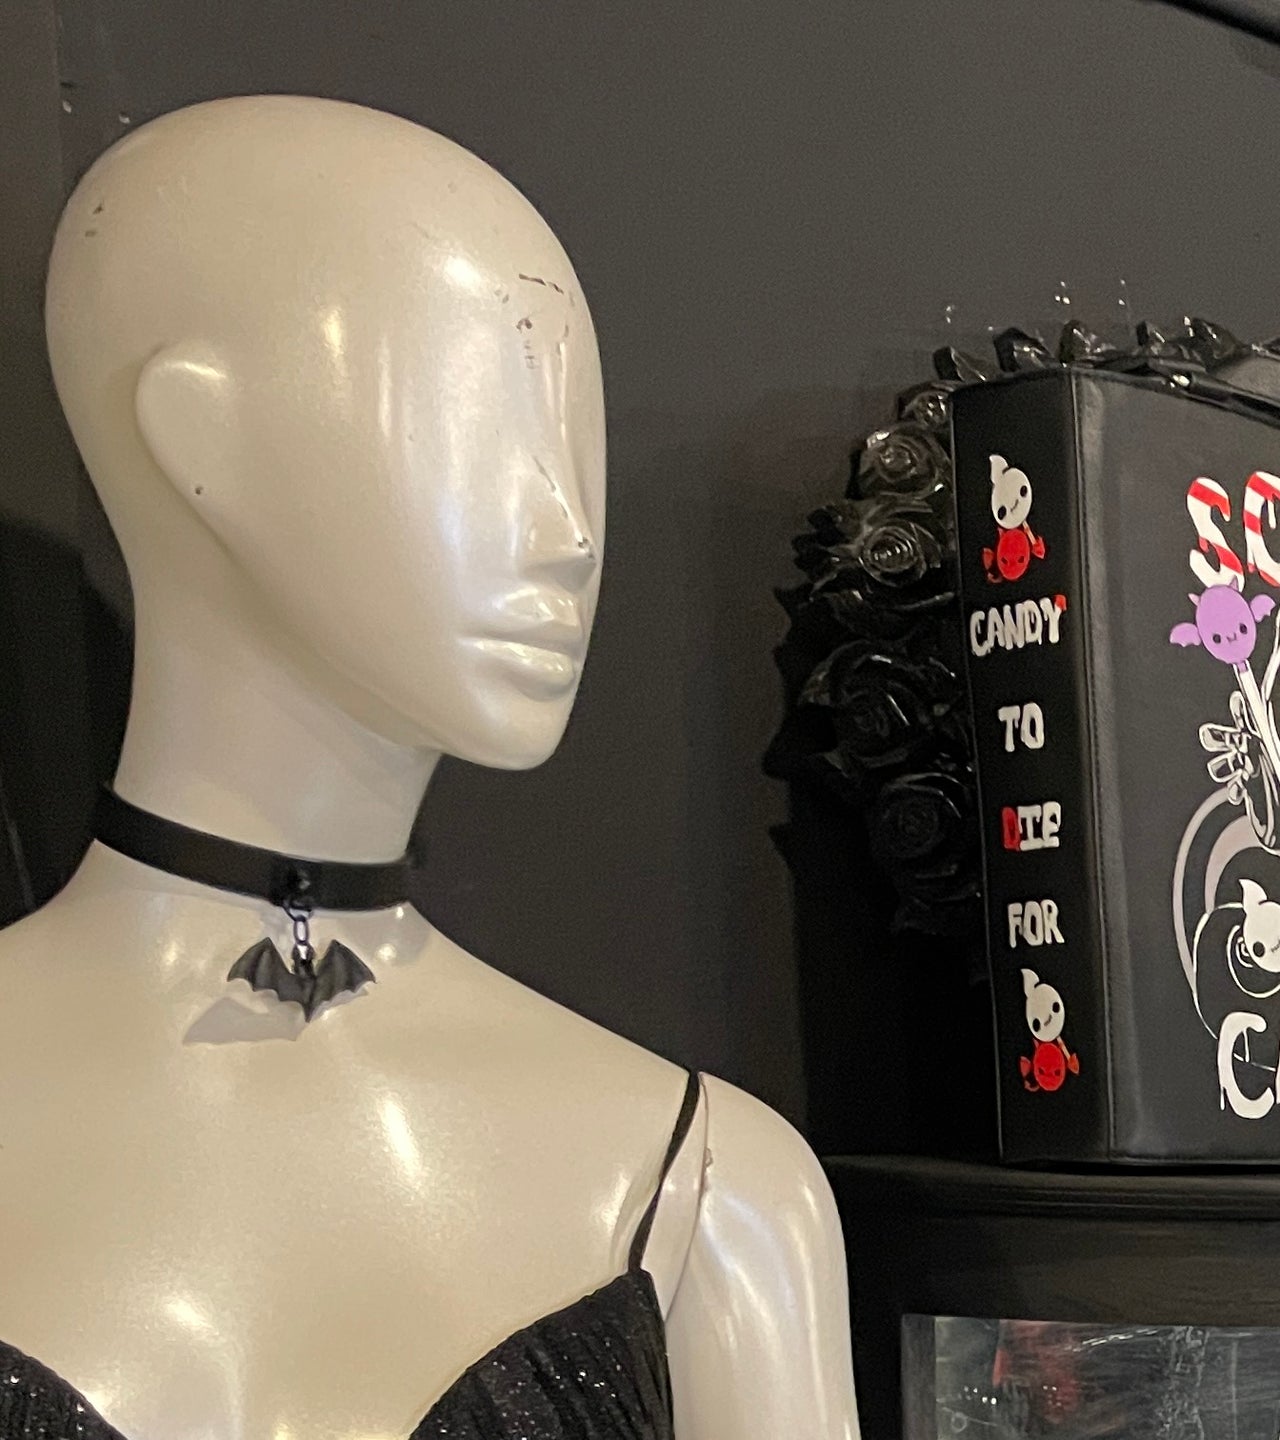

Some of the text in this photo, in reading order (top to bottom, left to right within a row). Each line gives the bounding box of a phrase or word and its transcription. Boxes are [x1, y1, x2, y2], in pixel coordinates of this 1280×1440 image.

[969, 595, 1067, 657] CANDY
[999, 702, 1044, 752] TO
[1002, 803, 1062, 851] DIE
[1007, 899, 1065, 948] FOR
